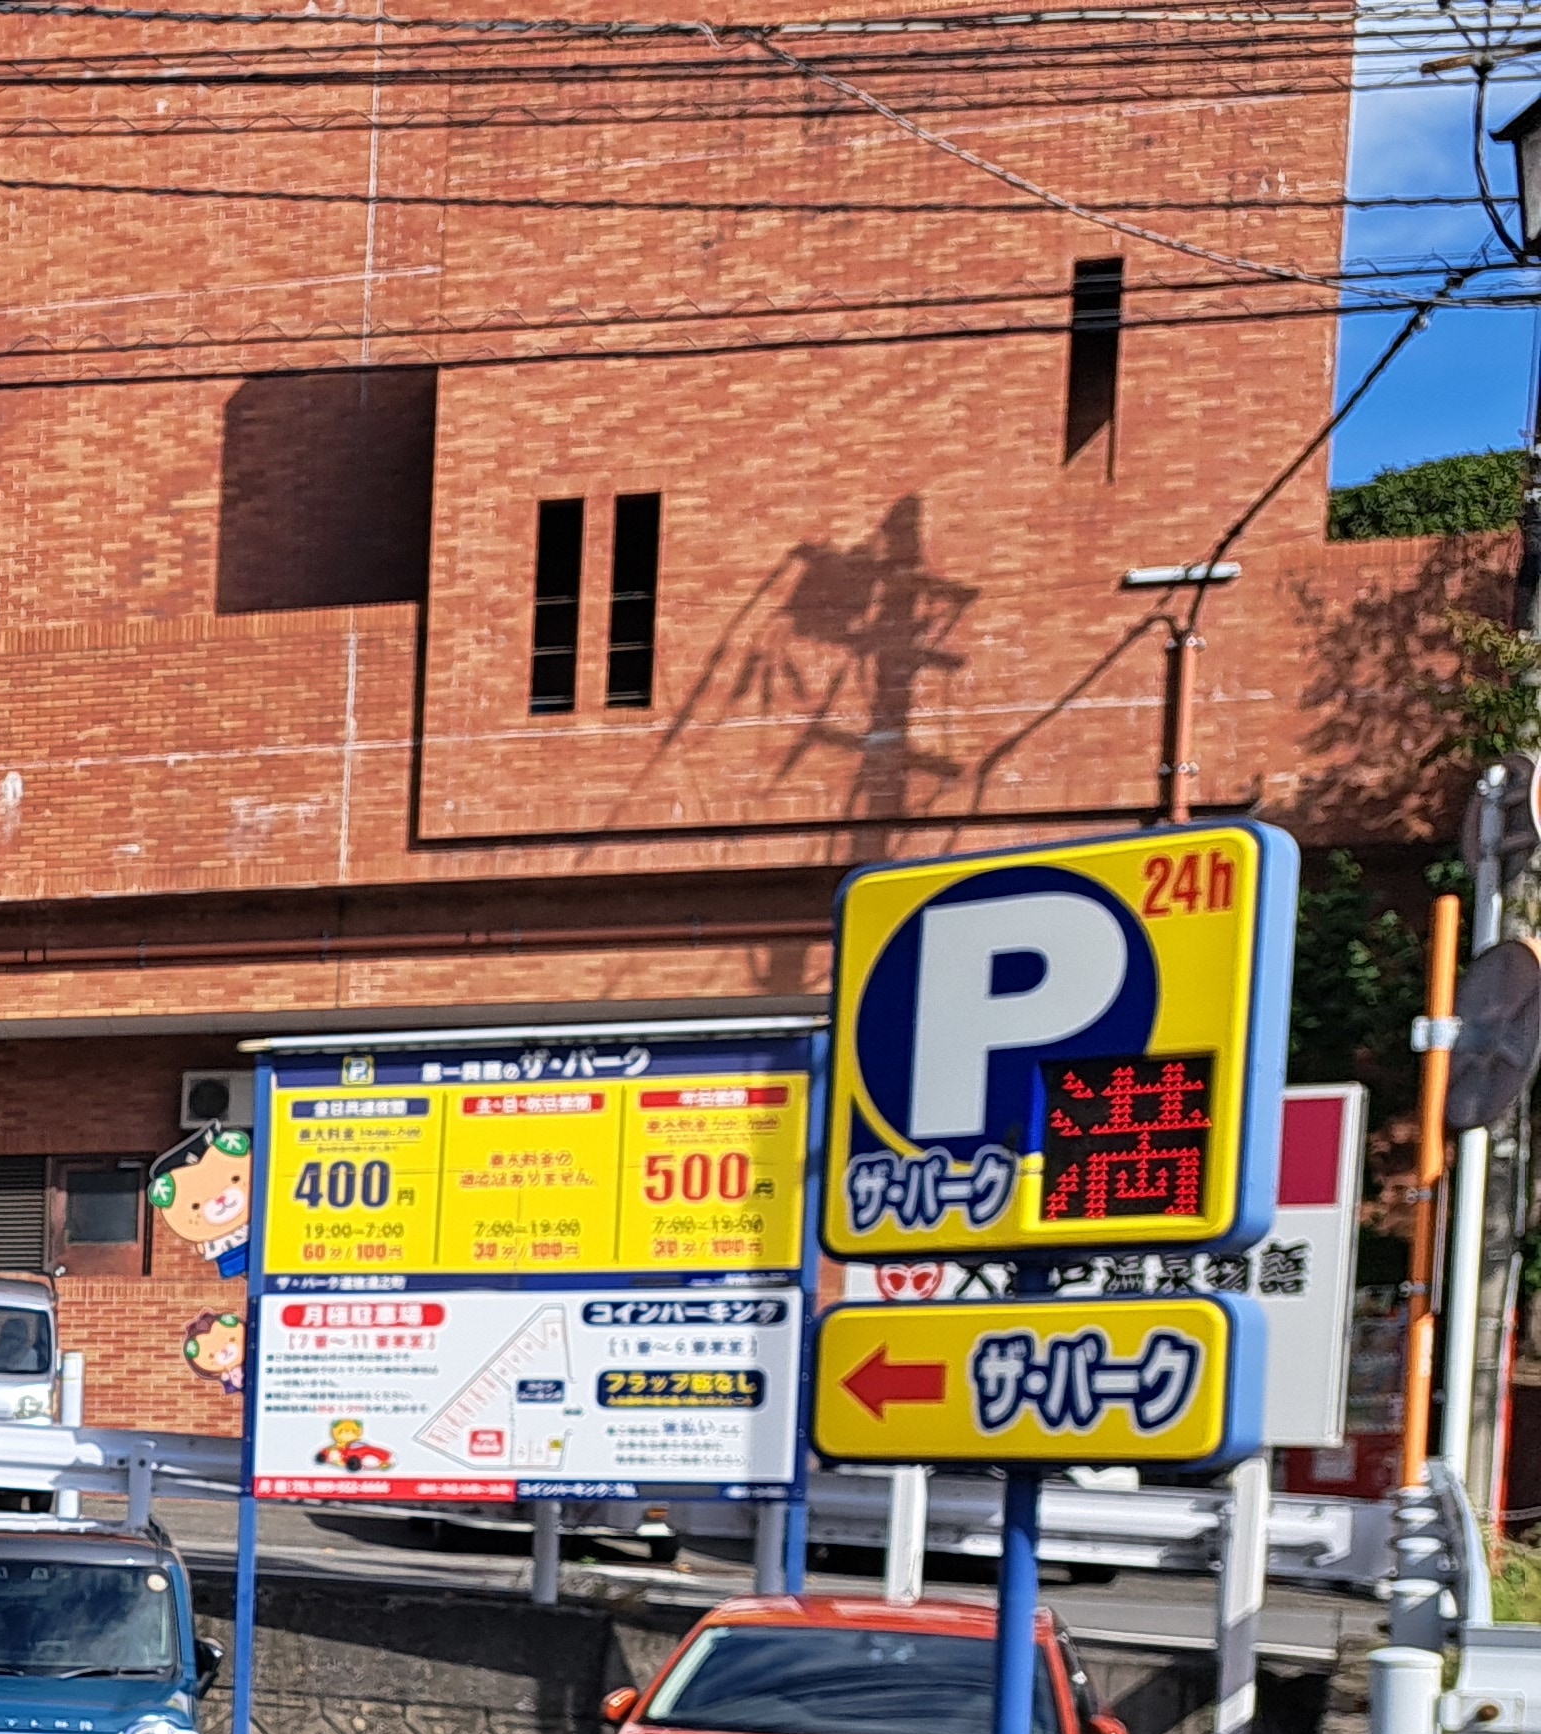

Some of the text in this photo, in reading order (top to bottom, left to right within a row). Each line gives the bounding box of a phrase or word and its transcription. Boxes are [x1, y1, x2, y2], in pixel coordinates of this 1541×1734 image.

[1142, 851, 1235, 917] 24h
[910, 890, 1128, 1140] P
[1047, 1062, 1212, 1221] 満
[848, 1148, 1015, 1233] ザ・パーク
[302, 1303, 424, 1327] 月極駐車場
[589, 1302, 779, 1324] コインパーキング
[974, 1333, 1199, 1429] ザ・パーク
